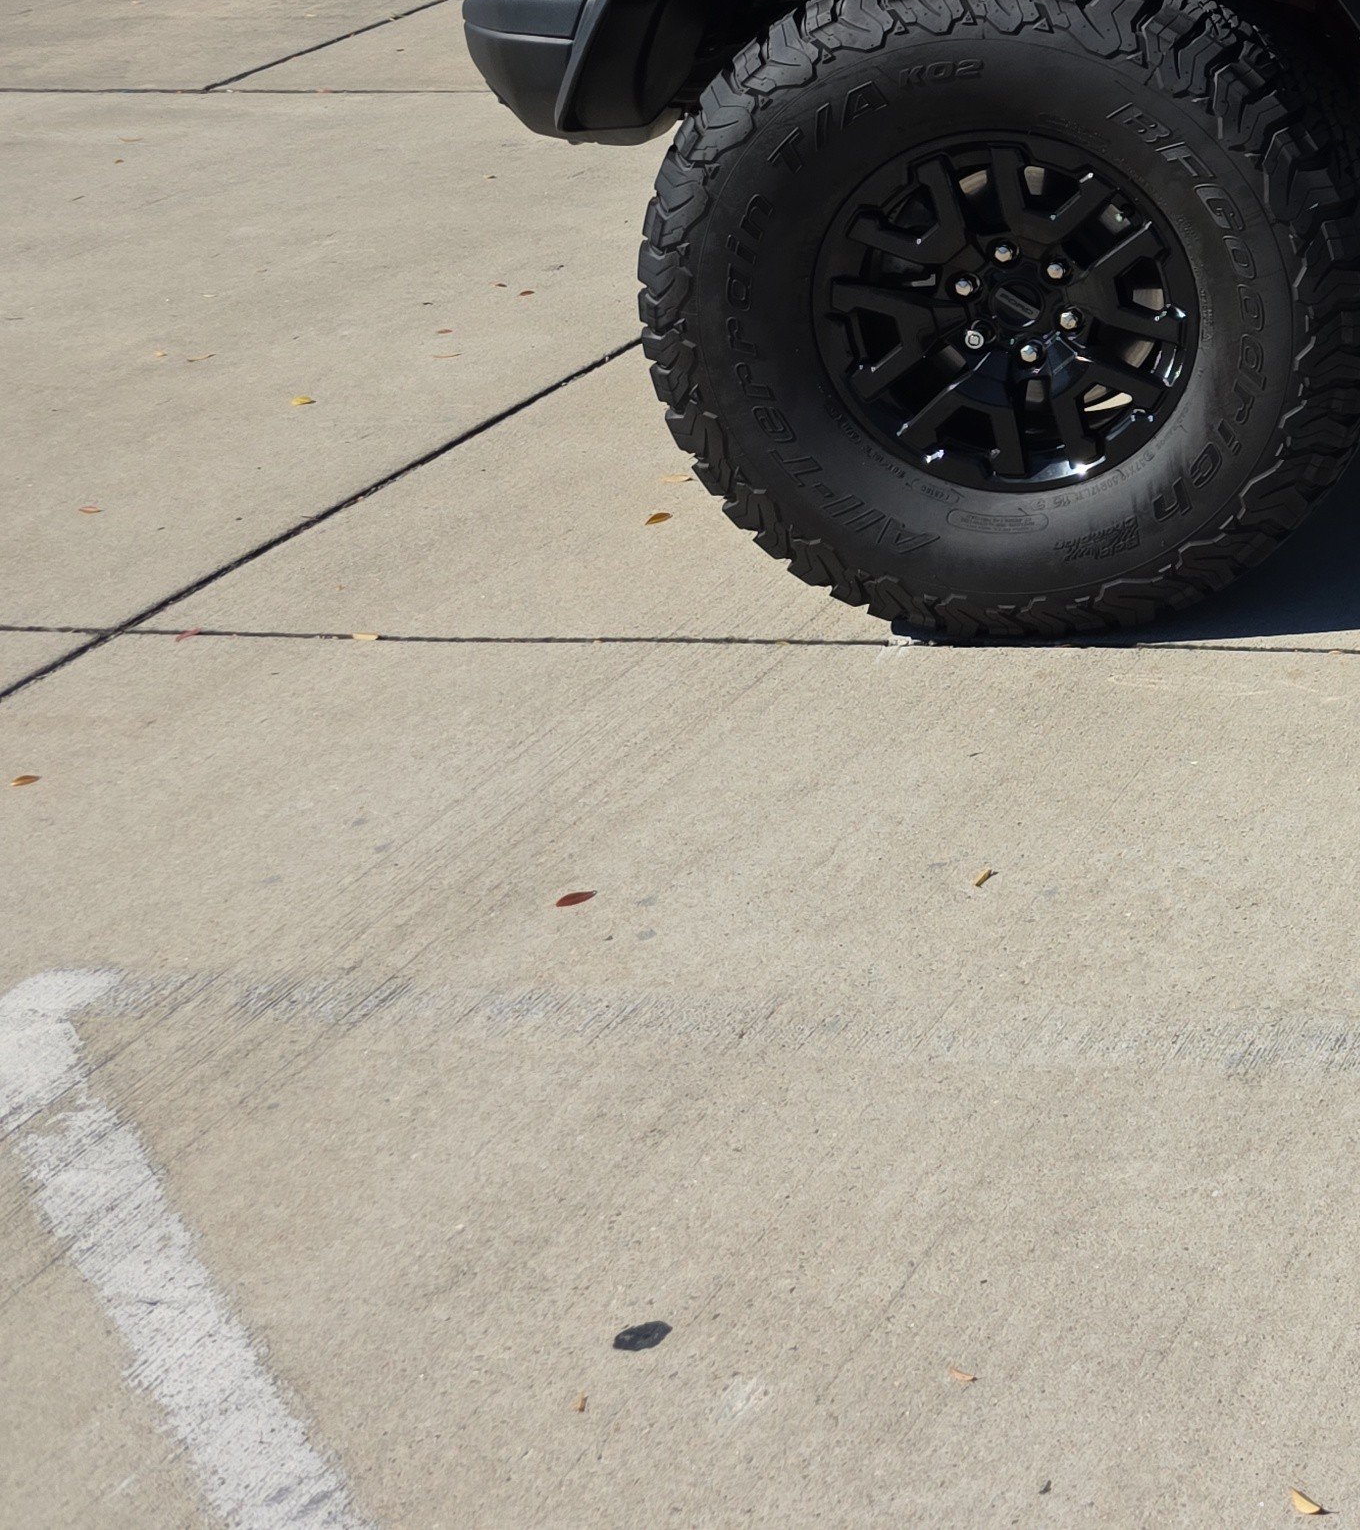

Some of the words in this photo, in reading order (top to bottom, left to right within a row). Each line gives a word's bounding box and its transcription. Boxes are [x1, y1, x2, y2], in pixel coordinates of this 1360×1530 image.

[765, 79, 890, 175] T/A
[724, 192, 942, 555] All-Terrain
[1105, 100, 1268, 522] BFGoodrich
